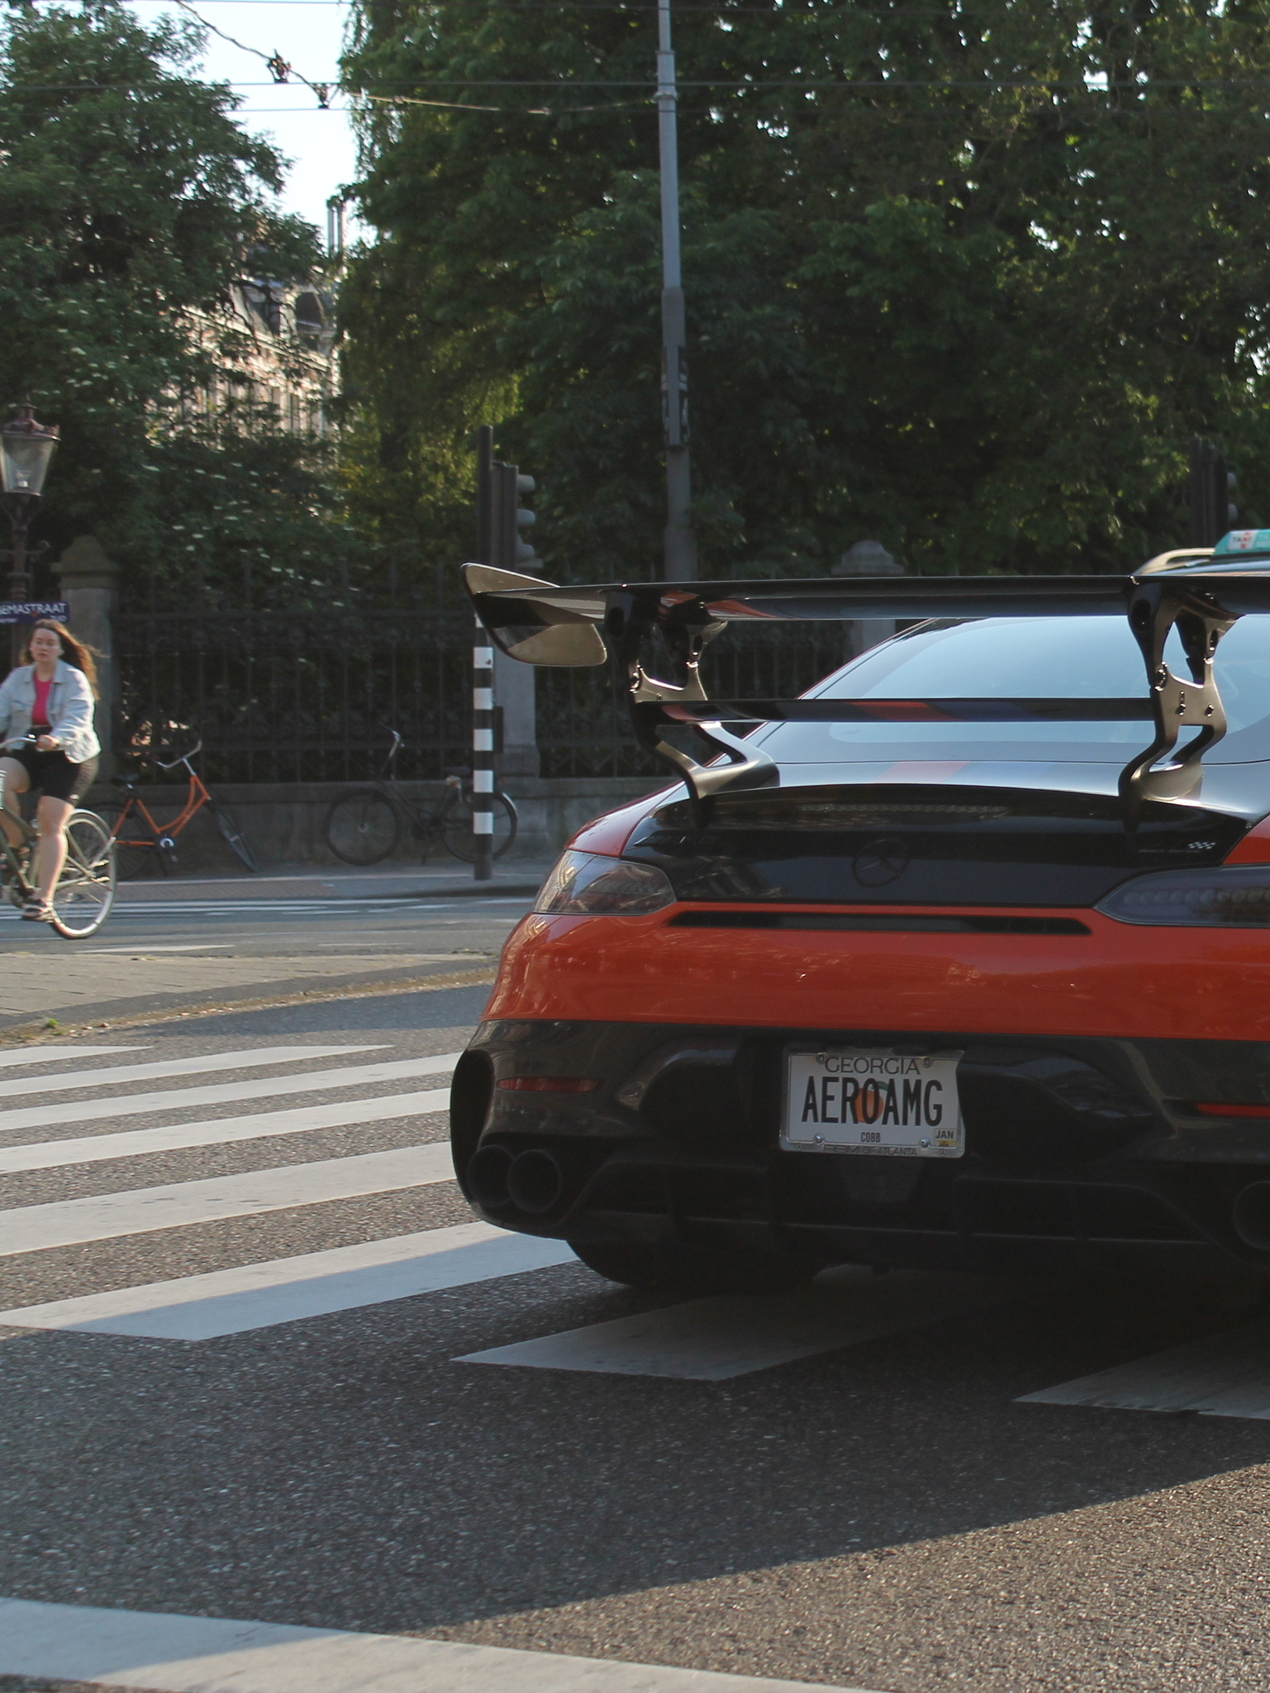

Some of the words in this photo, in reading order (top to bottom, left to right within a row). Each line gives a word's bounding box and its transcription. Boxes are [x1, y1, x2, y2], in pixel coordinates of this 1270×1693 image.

[825, 1057, 921, 1075] GEORGIA
[801, 1075, 944, 1127] AEROAMG
[860, 1131, 881, 1143] COBB
[935, 1130, 954, 1139] JAN
[877, 1147, 918, 1156] ATLANTA
